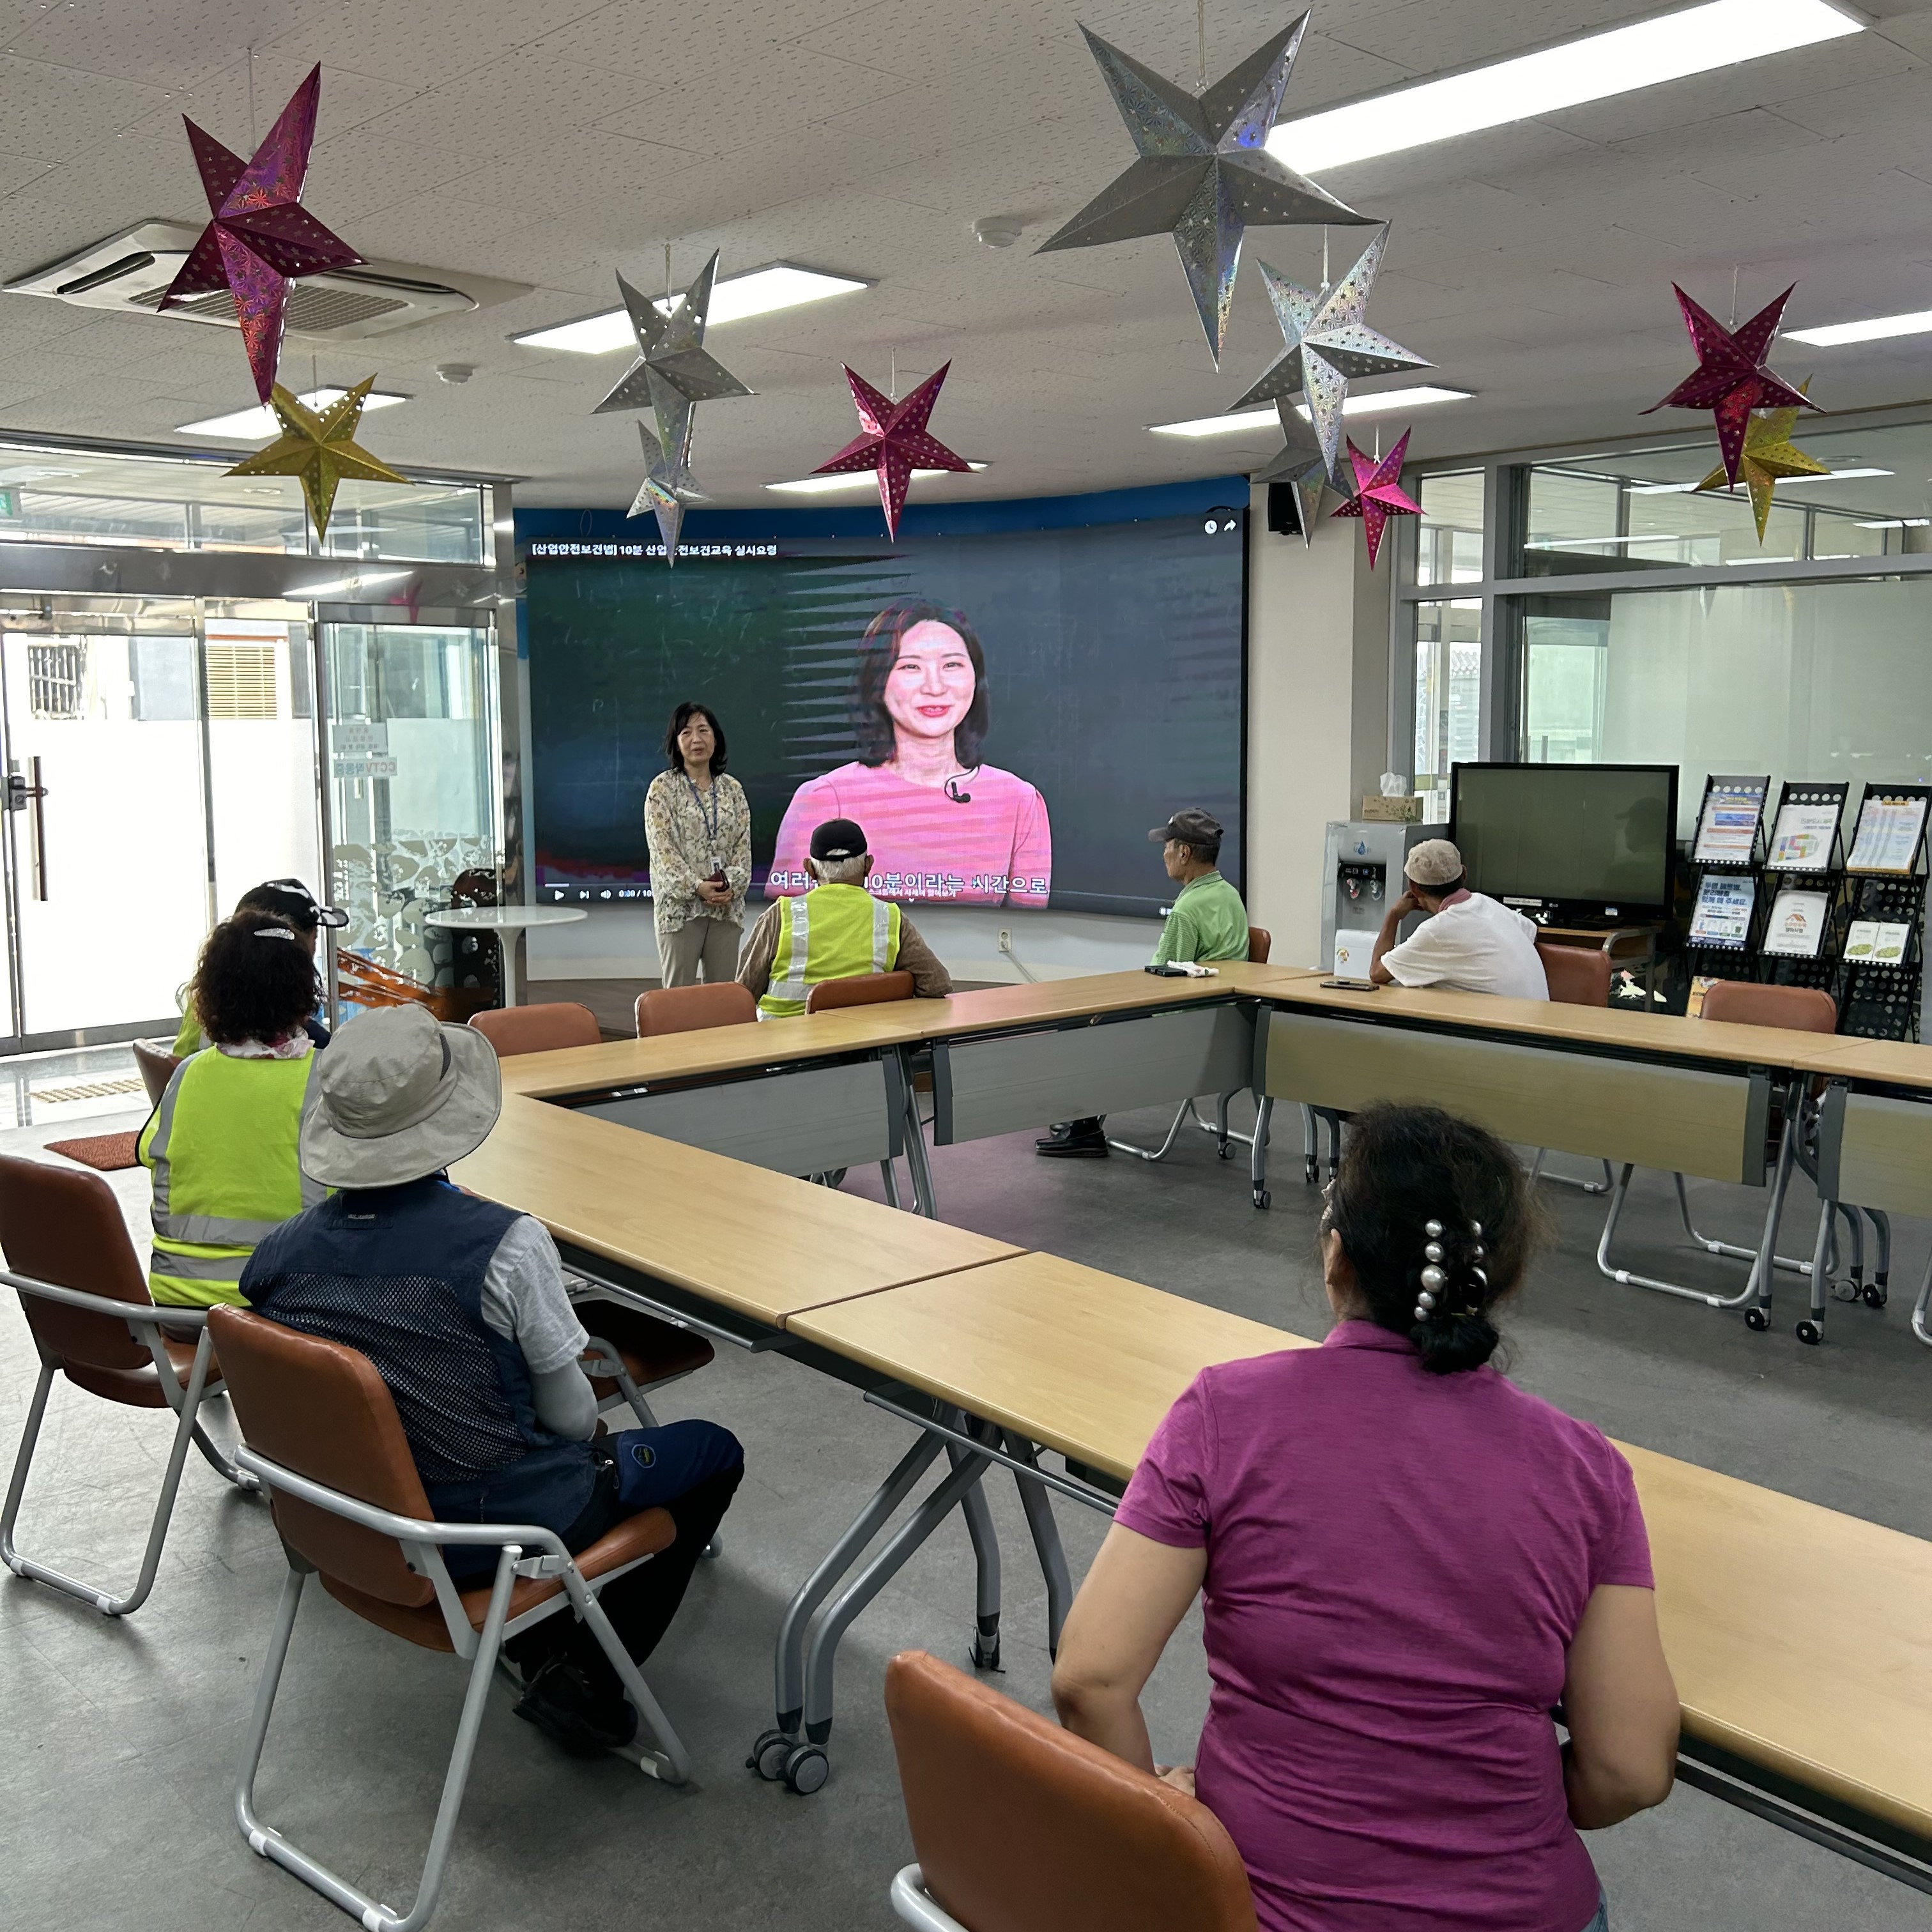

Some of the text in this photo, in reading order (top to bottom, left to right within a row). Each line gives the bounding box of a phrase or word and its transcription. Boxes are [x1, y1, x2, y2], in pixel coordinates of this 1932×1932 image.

[619, 545, 643, 556] 10분
[645, 544, 732, 556] 산업전보건교육
[735, 544, 777, 556] 실시요령
[974, 874, 1048, 894] 시간으로
[642, 889, 652, 898] 10
